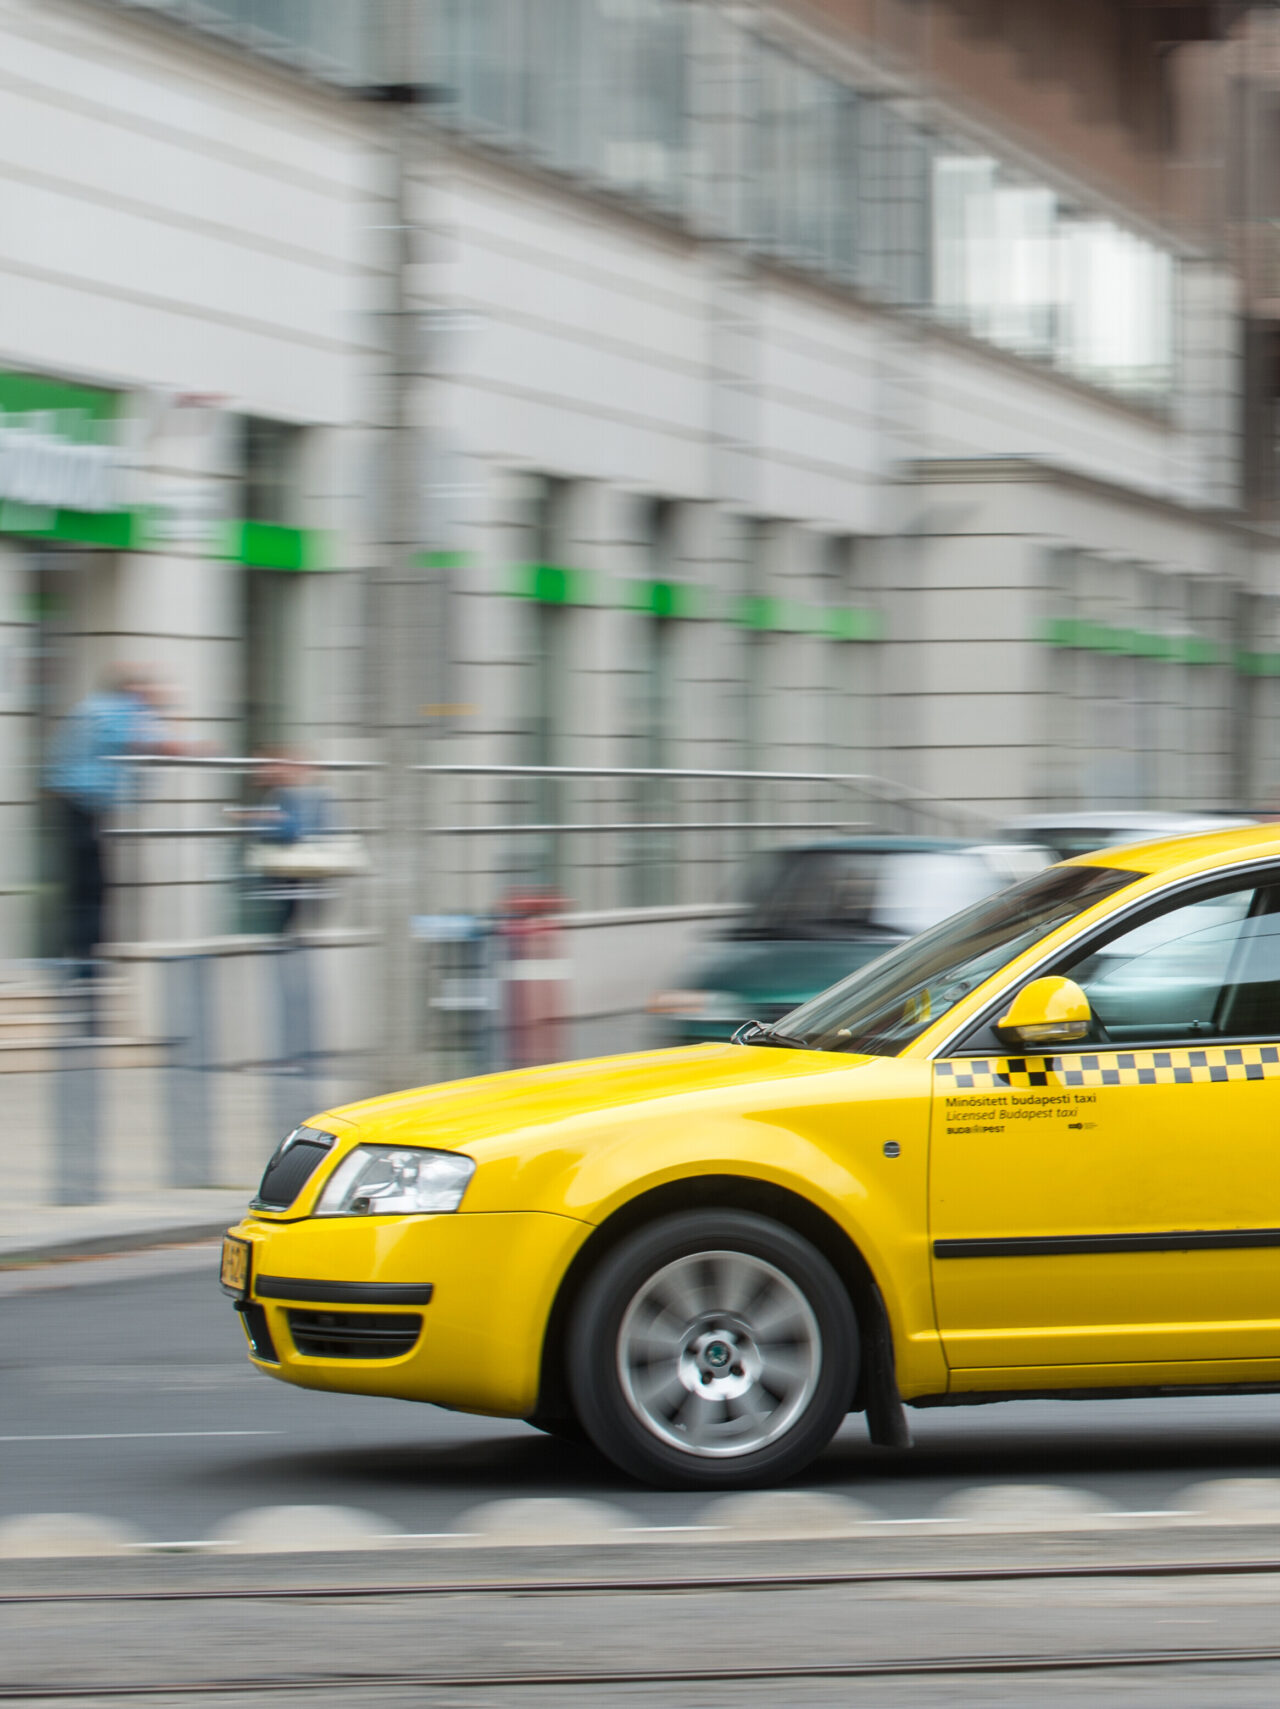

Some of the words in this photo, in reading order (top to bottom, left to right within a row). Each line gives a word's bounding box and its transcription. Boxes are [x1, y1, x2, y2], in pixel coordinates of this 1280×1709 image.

[1011, 1093, 1071, 1107] budapesti
[1074, 1092, 1097, 1104] taxi
[945, 1109, 996, 1121] Licensed
[1000, 1108, 1053, 1121] Budapest
[1056, 1106, 1078, 1118] taxi
